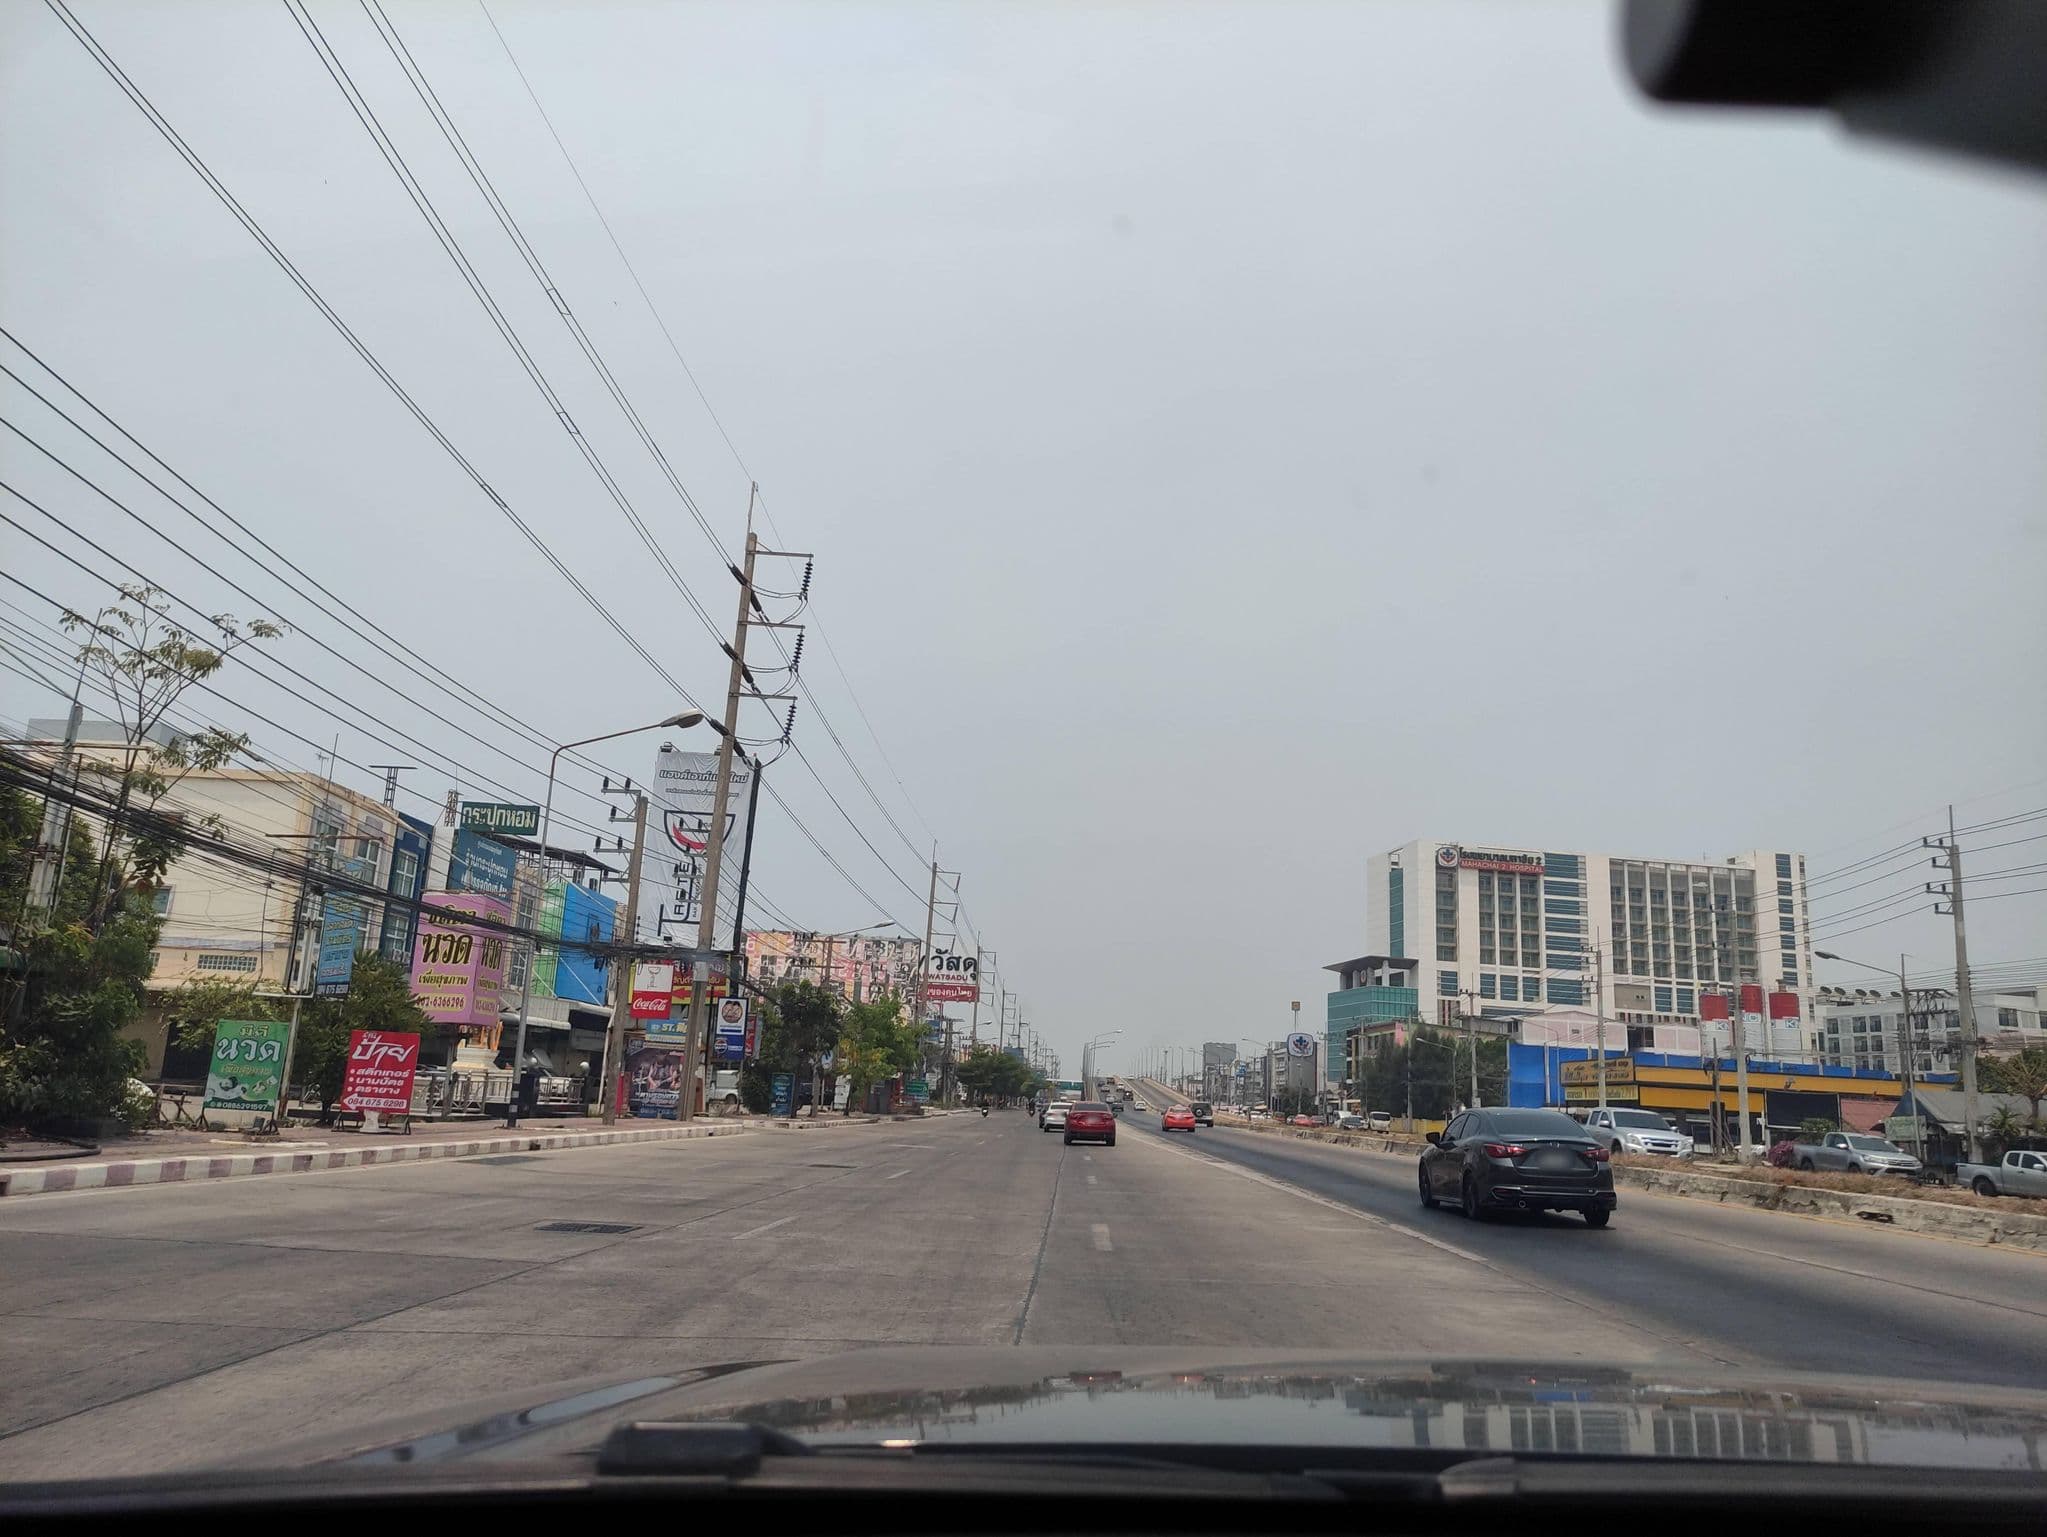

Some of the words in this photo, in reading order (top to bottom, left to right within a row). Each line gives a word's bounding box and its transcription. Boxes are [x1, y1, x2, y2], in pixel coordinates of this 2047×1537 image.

[1460, 860, 1499, 870] MAHACHAI
[1509, 864, 1544, 873] HOSPITAL
[422, 933, 473, 965] นวด
[930, 948, 977, 981] วัสดุ
[216, 1038, 281, 1062] นวด
[352, 1035, 416, 1068] ป้าย
[355, 1086, 401, 1094] ตรายาง
